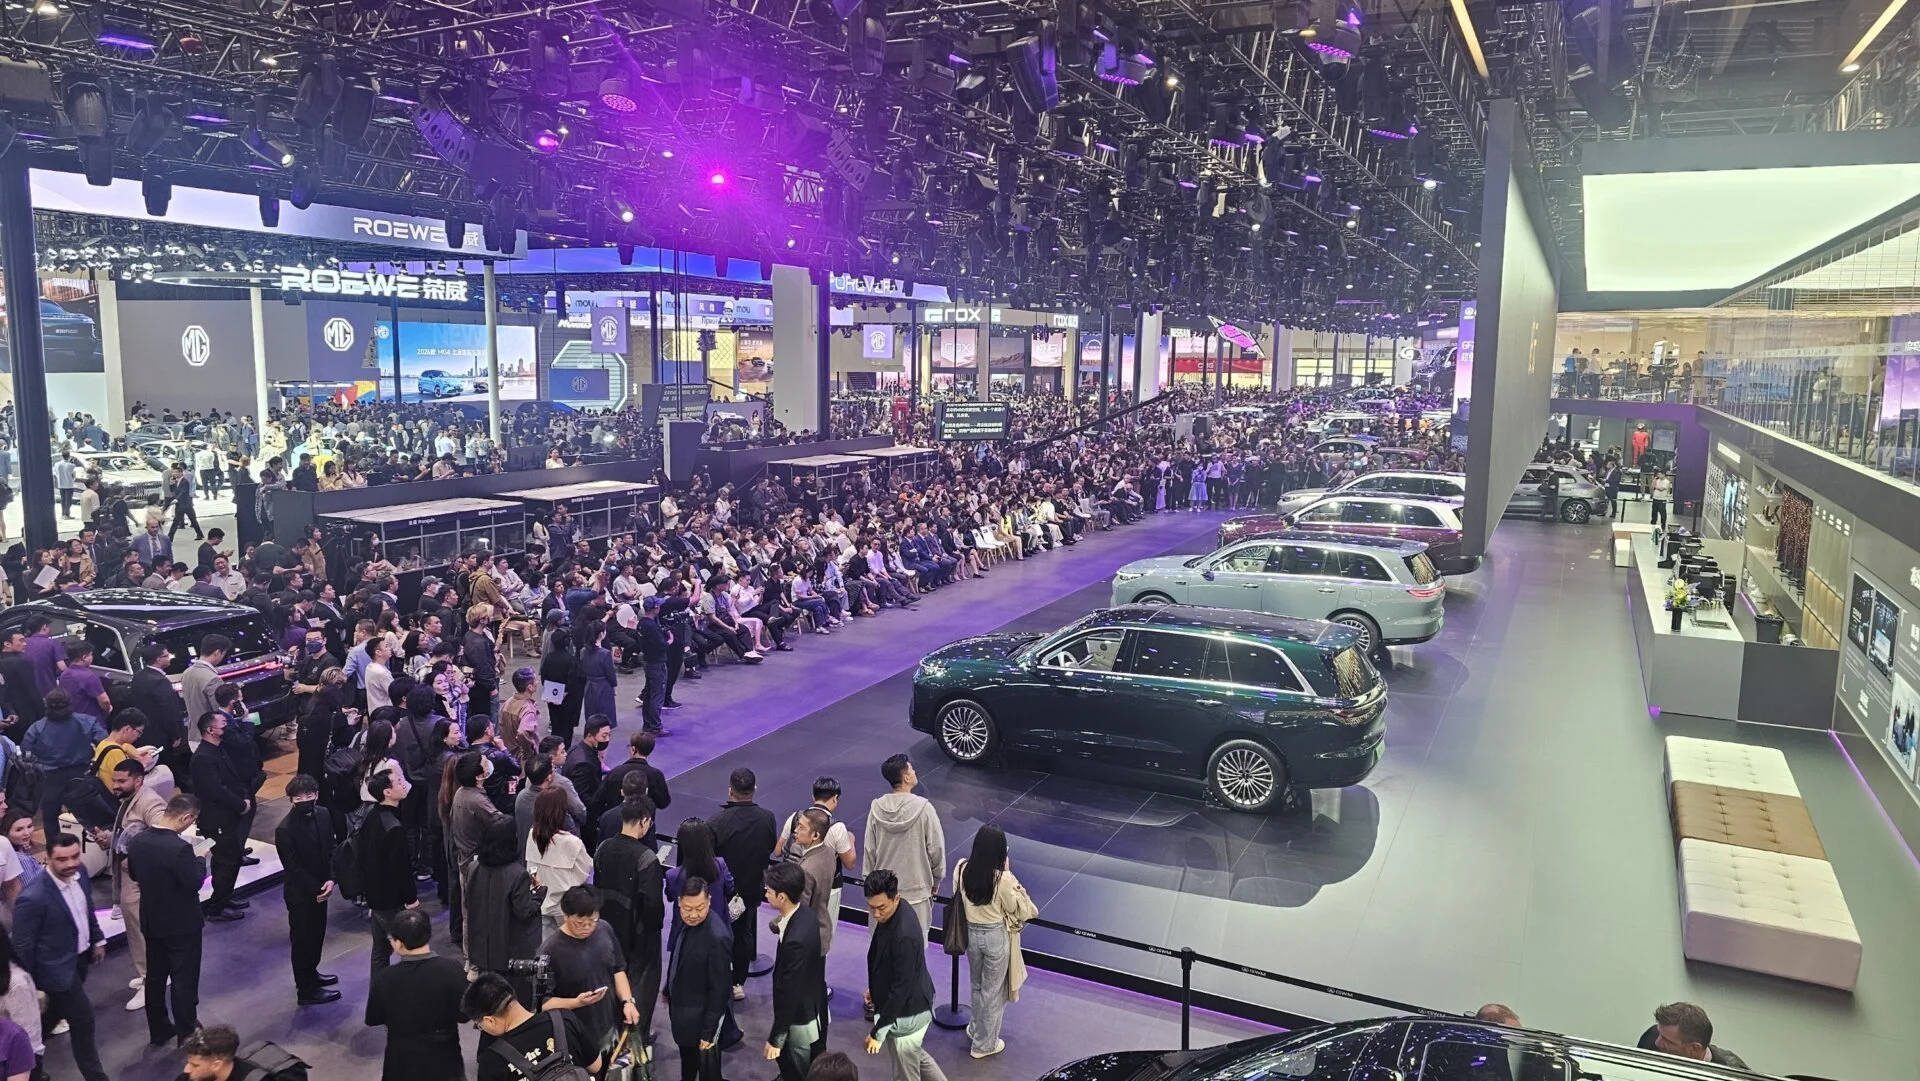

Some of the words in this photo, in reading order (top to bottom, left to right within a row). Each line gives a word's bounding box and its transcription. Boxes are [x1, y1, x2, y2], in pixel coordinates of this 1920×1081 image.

[353, 217, 445, 242] ROEWE
[280, 266, 420, 298] ROEWE
[422, 278, 468, 302] 荣威
[182, 326, 210, 366] MG
[324, 318, 354, 351] MG
